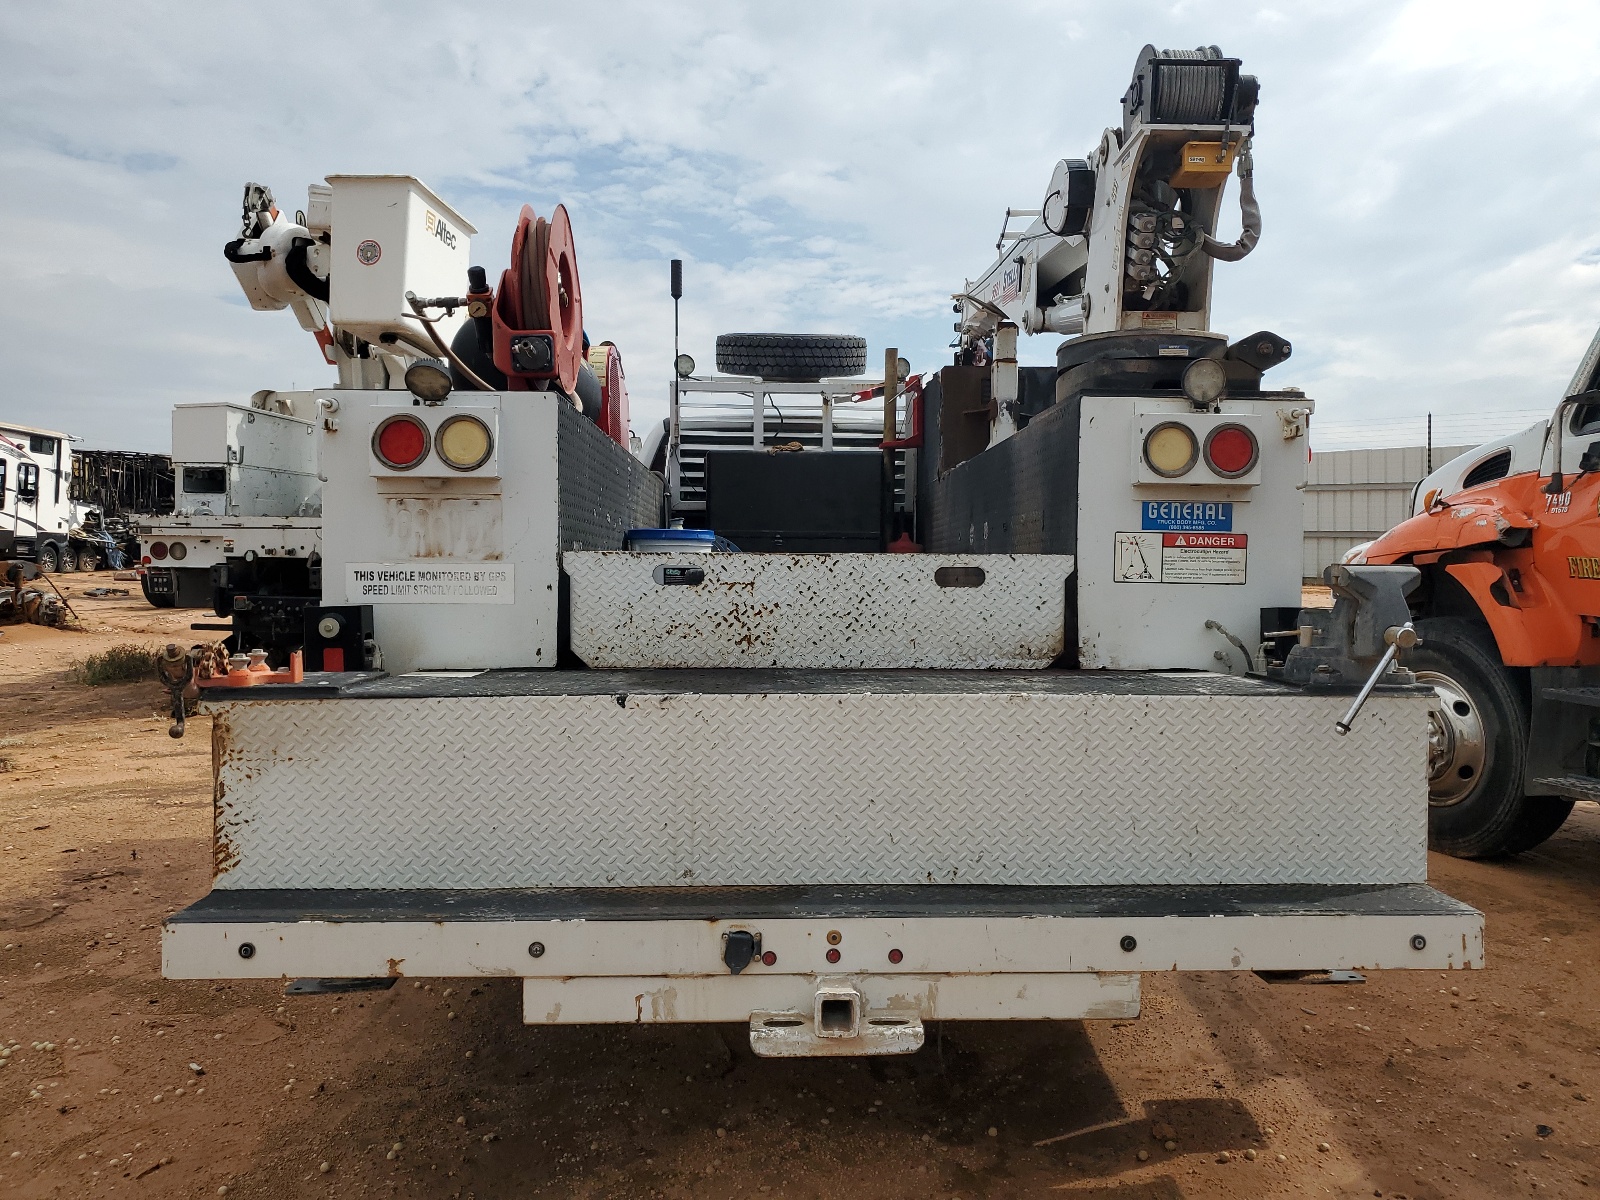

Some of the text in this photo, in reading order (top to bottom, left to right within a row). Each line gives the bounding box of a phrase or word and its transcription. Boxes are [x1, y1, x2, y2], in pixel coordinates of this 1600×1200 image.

[435, 219, 456, 250] Altec
[1148, 502, 1226, 520] GENERAL
[1189, 536, 1235, 546] DANGER
[1568, 556, 1600, 580] FIRE
[354, 570, 507, 582] THIS VEHICLE MONITORED BY GPS
[362, 584, 389, 596] SPEED
[390, 584, 412, 596] LIMIT
[413, 584, 451, 596] STRICTLY
